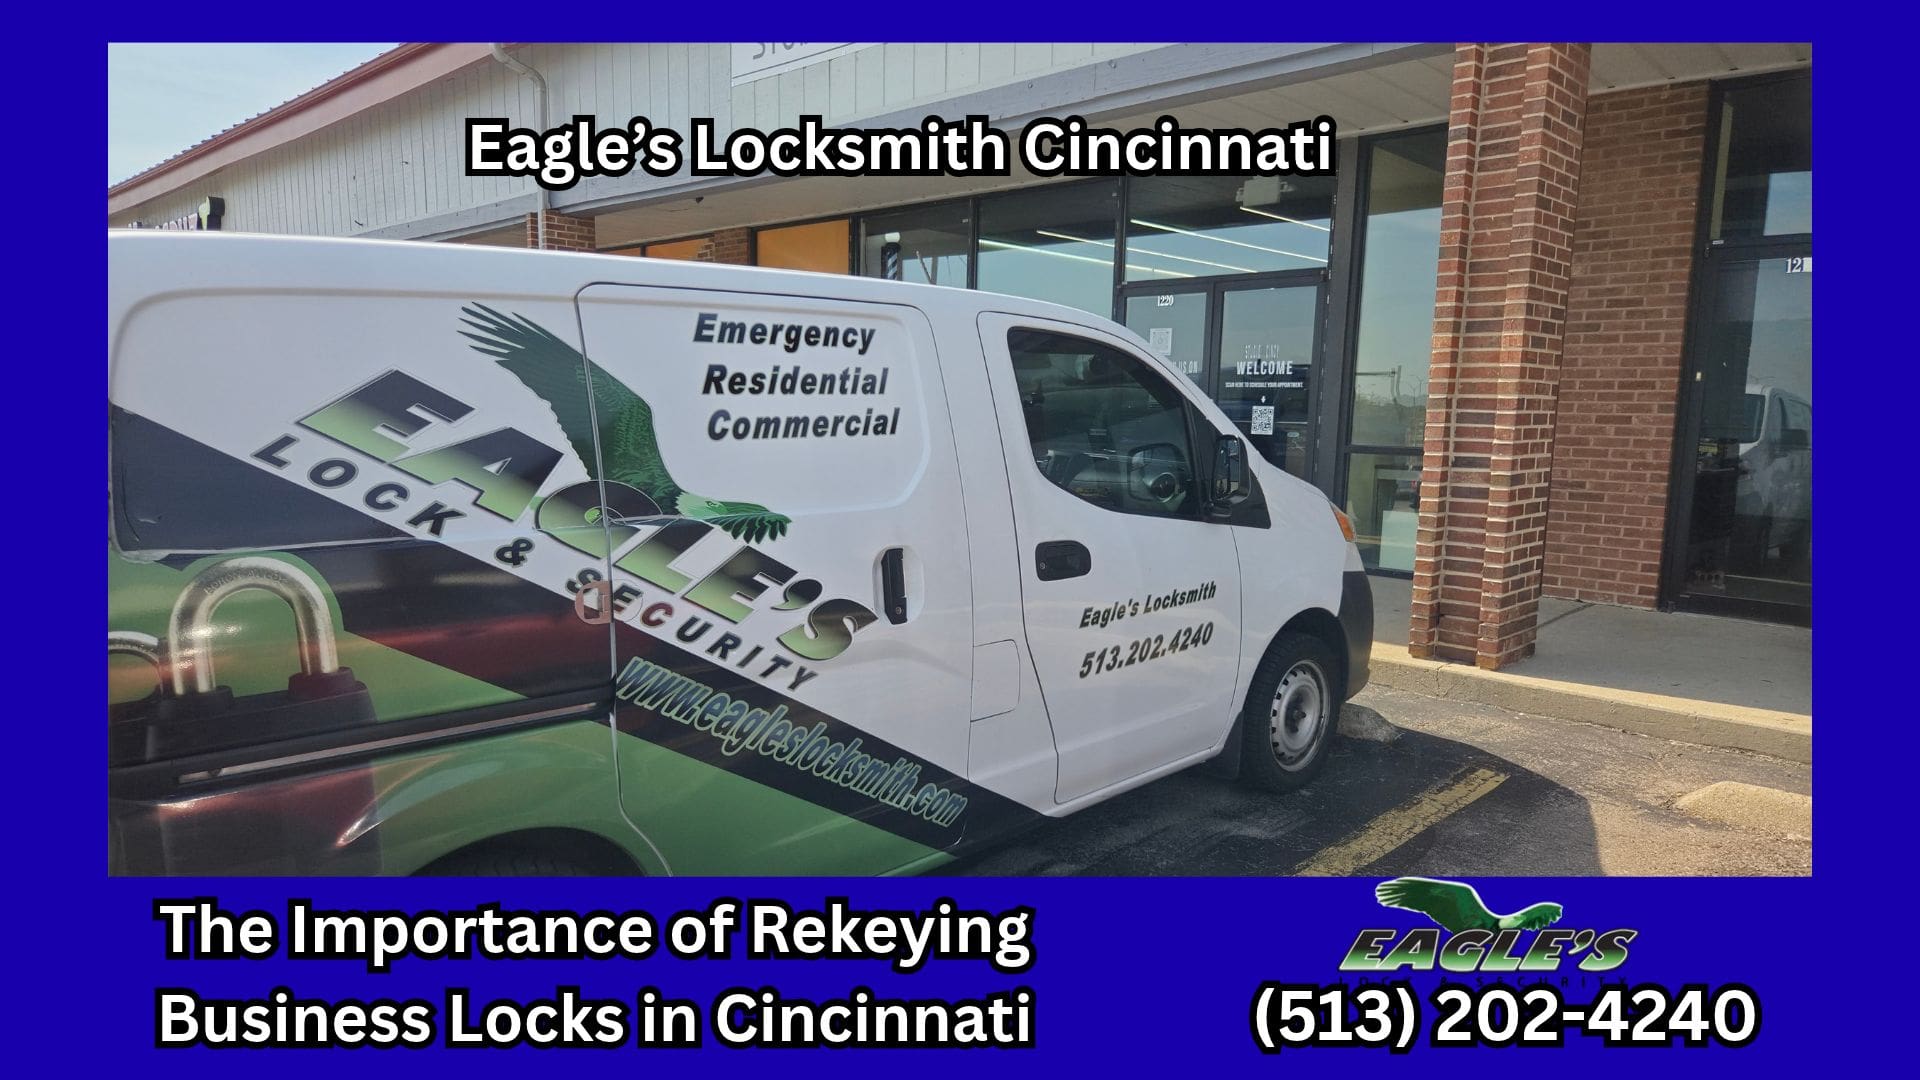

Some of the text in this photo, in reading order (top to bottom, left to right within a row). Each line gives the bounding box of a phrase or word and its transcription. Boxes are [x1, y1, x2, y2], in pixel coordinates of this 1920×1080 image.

[1157, 294, 1174, 307] 1220
[692, 312, 877, 355] Emergency
[702, 364, 890, 397] Residential
[1236, 360, 1293, 375] WELCOME
[707, 407, 900, 441] Commercial
[250, 433, 818, 691] LOCK & SECURITY
[1078, 580, 1217, 629] Eagle's Locksmith
[1078, 621, 1214, 679] 513.202.4240
[614, 656, 969, 828] www.eagleslocksmith.com
